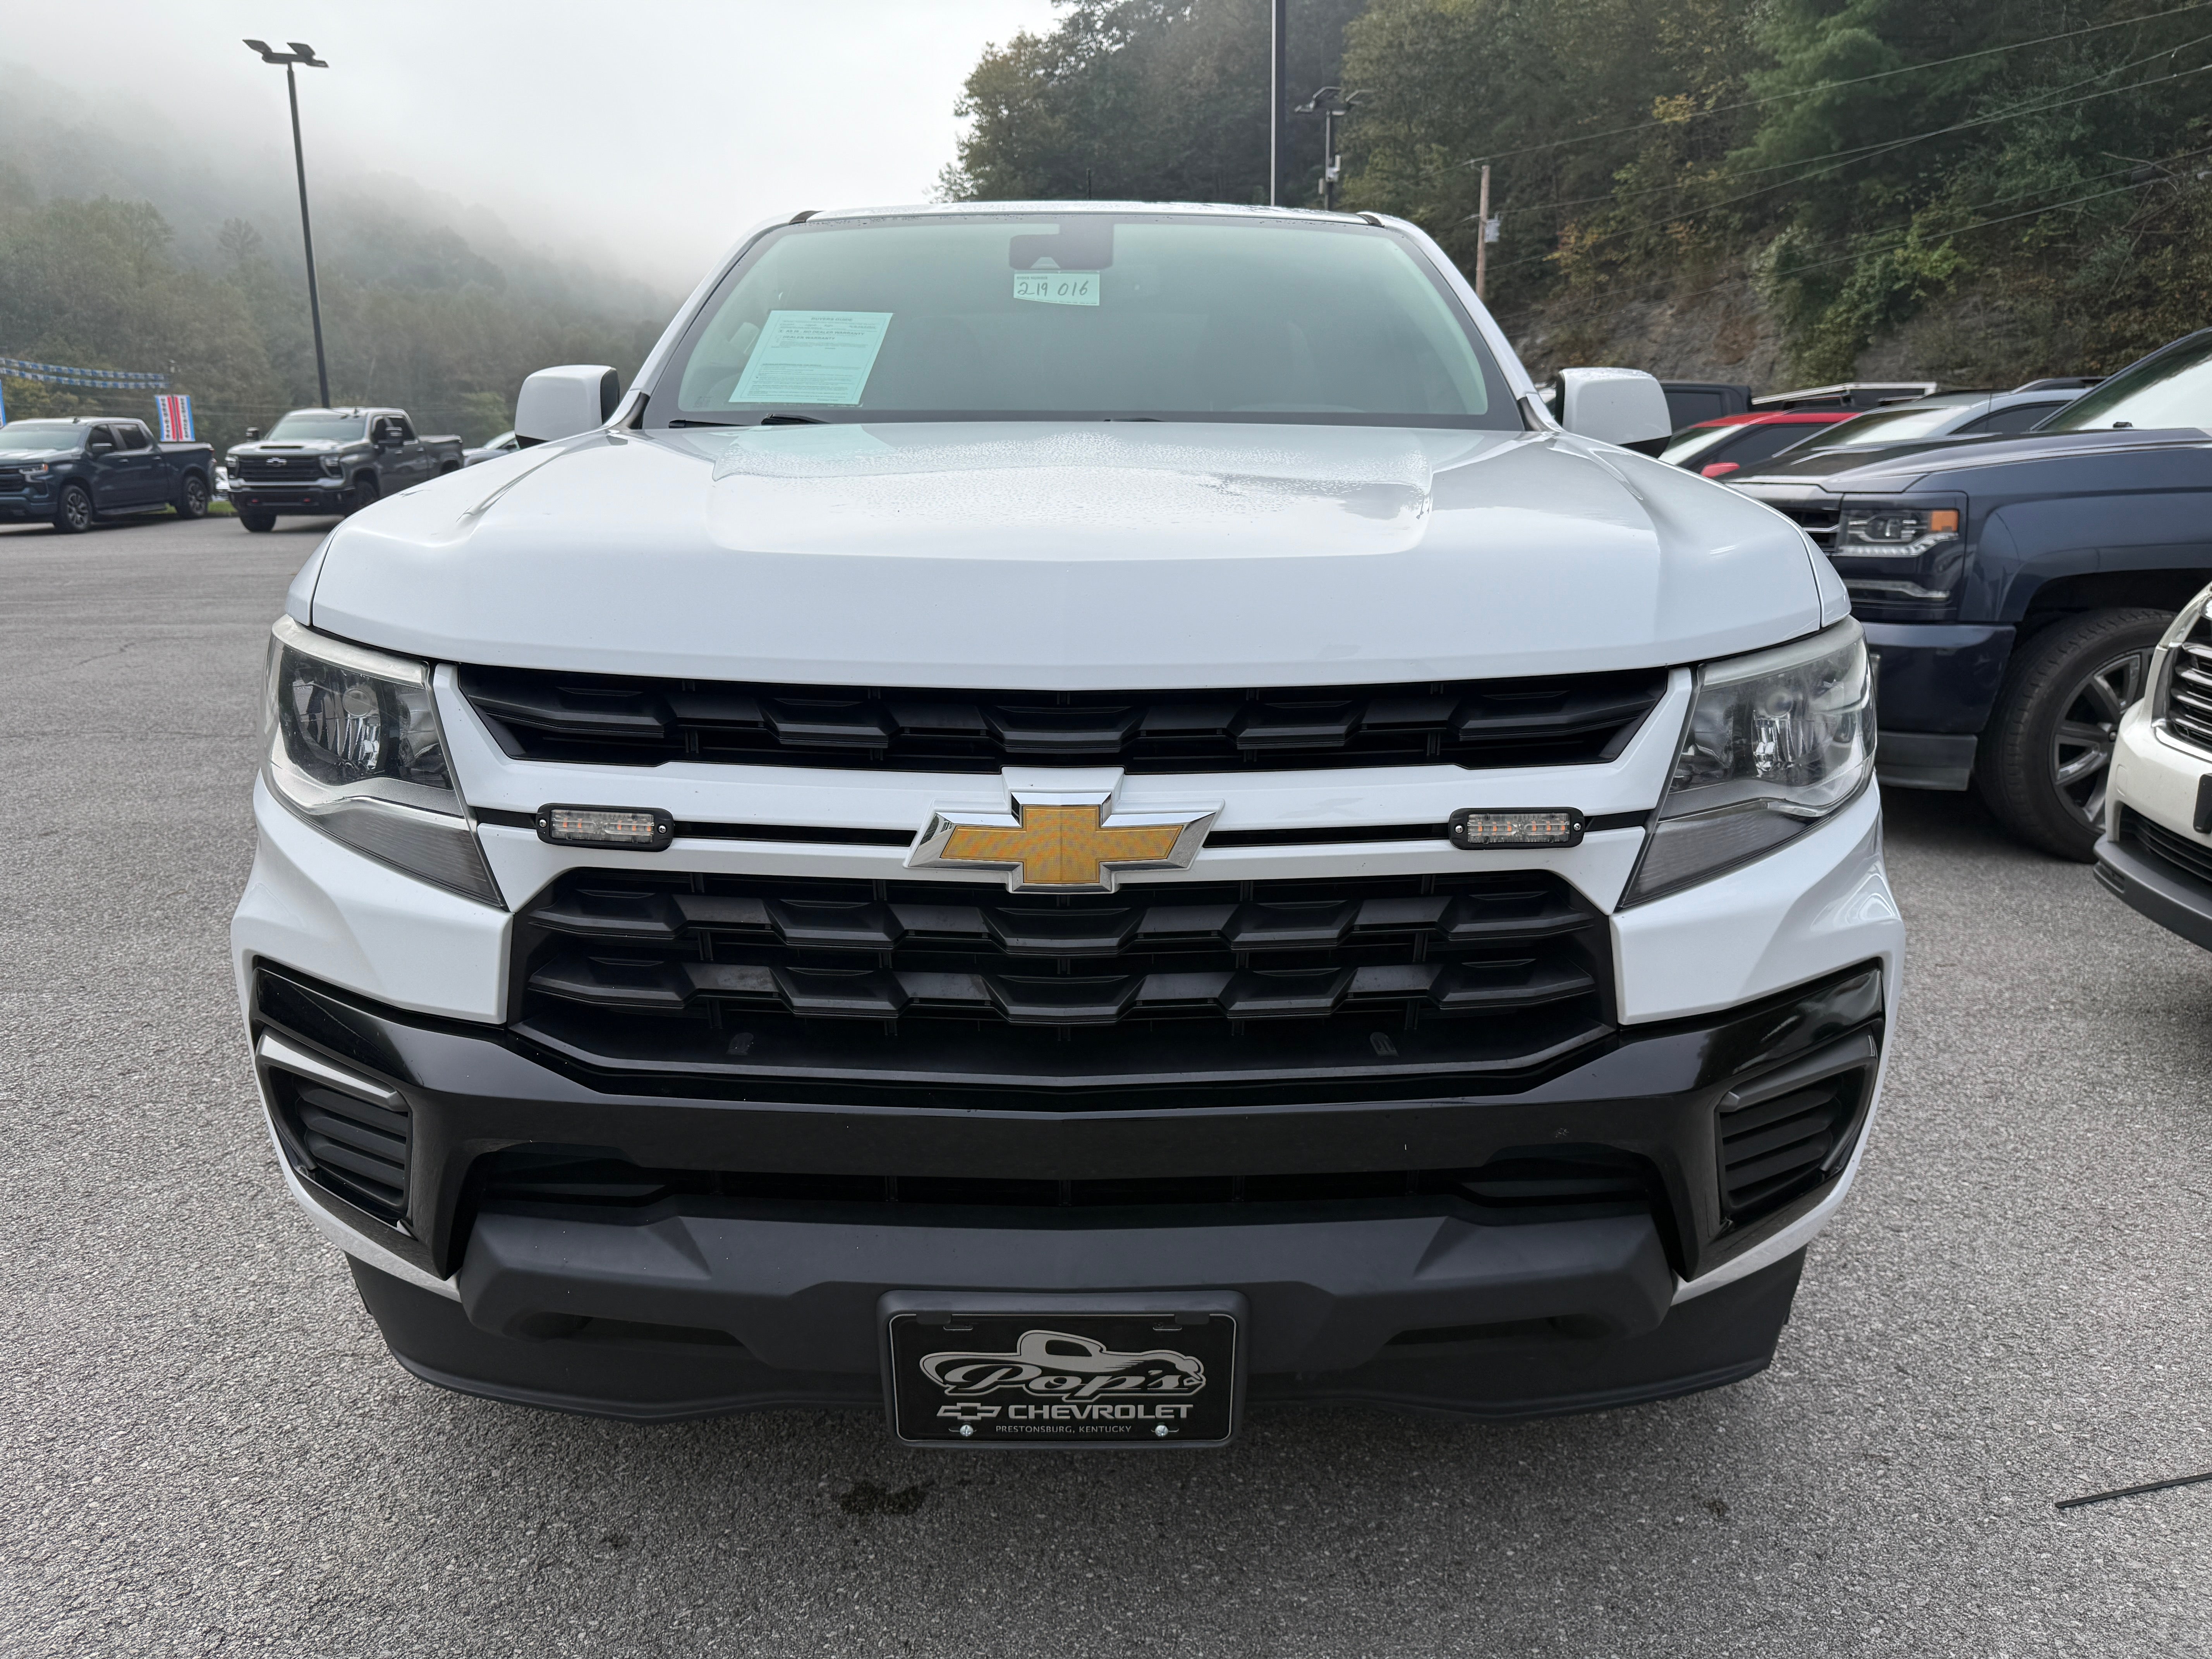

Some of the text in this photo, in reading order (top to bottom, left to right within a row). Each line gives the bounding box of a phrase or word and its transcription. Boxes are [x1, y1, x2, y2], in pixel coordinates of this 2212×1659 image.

[1017, 280, 1089, 297] 219 016
[944, 1364, 1188, 1396] Pop's
[1008, 1405, 1194, 1419] CHEVROLET
